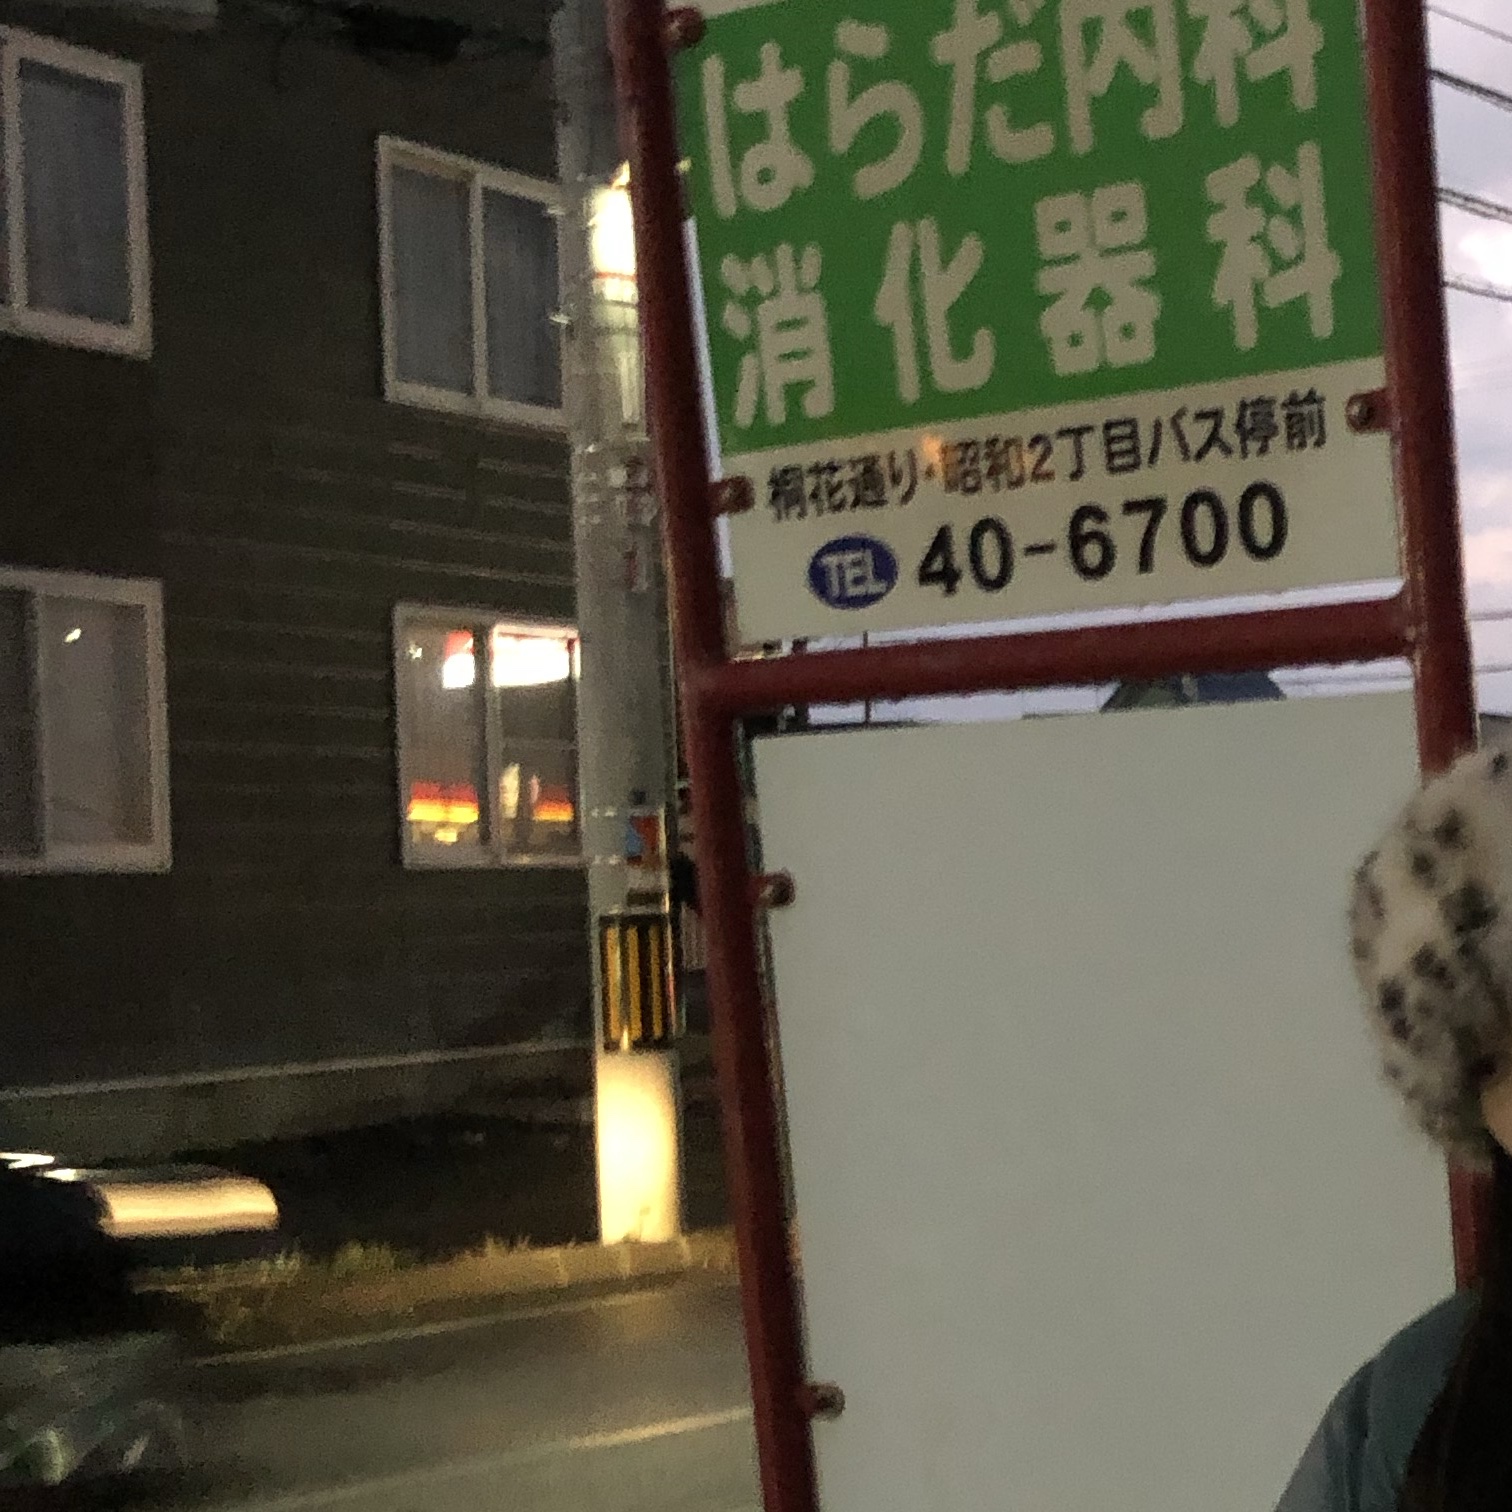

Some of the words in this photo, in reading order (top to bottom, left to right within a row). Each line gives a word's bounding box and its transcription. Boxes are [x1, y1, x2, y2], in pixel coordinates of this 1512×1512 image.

[702, 0, 1324, 219] はらだ内科
[721, 140, 1342, 428] 消化器科
[818, 545, 889, 602] TEL
[917, 480, 1289, 594] 40-6700
